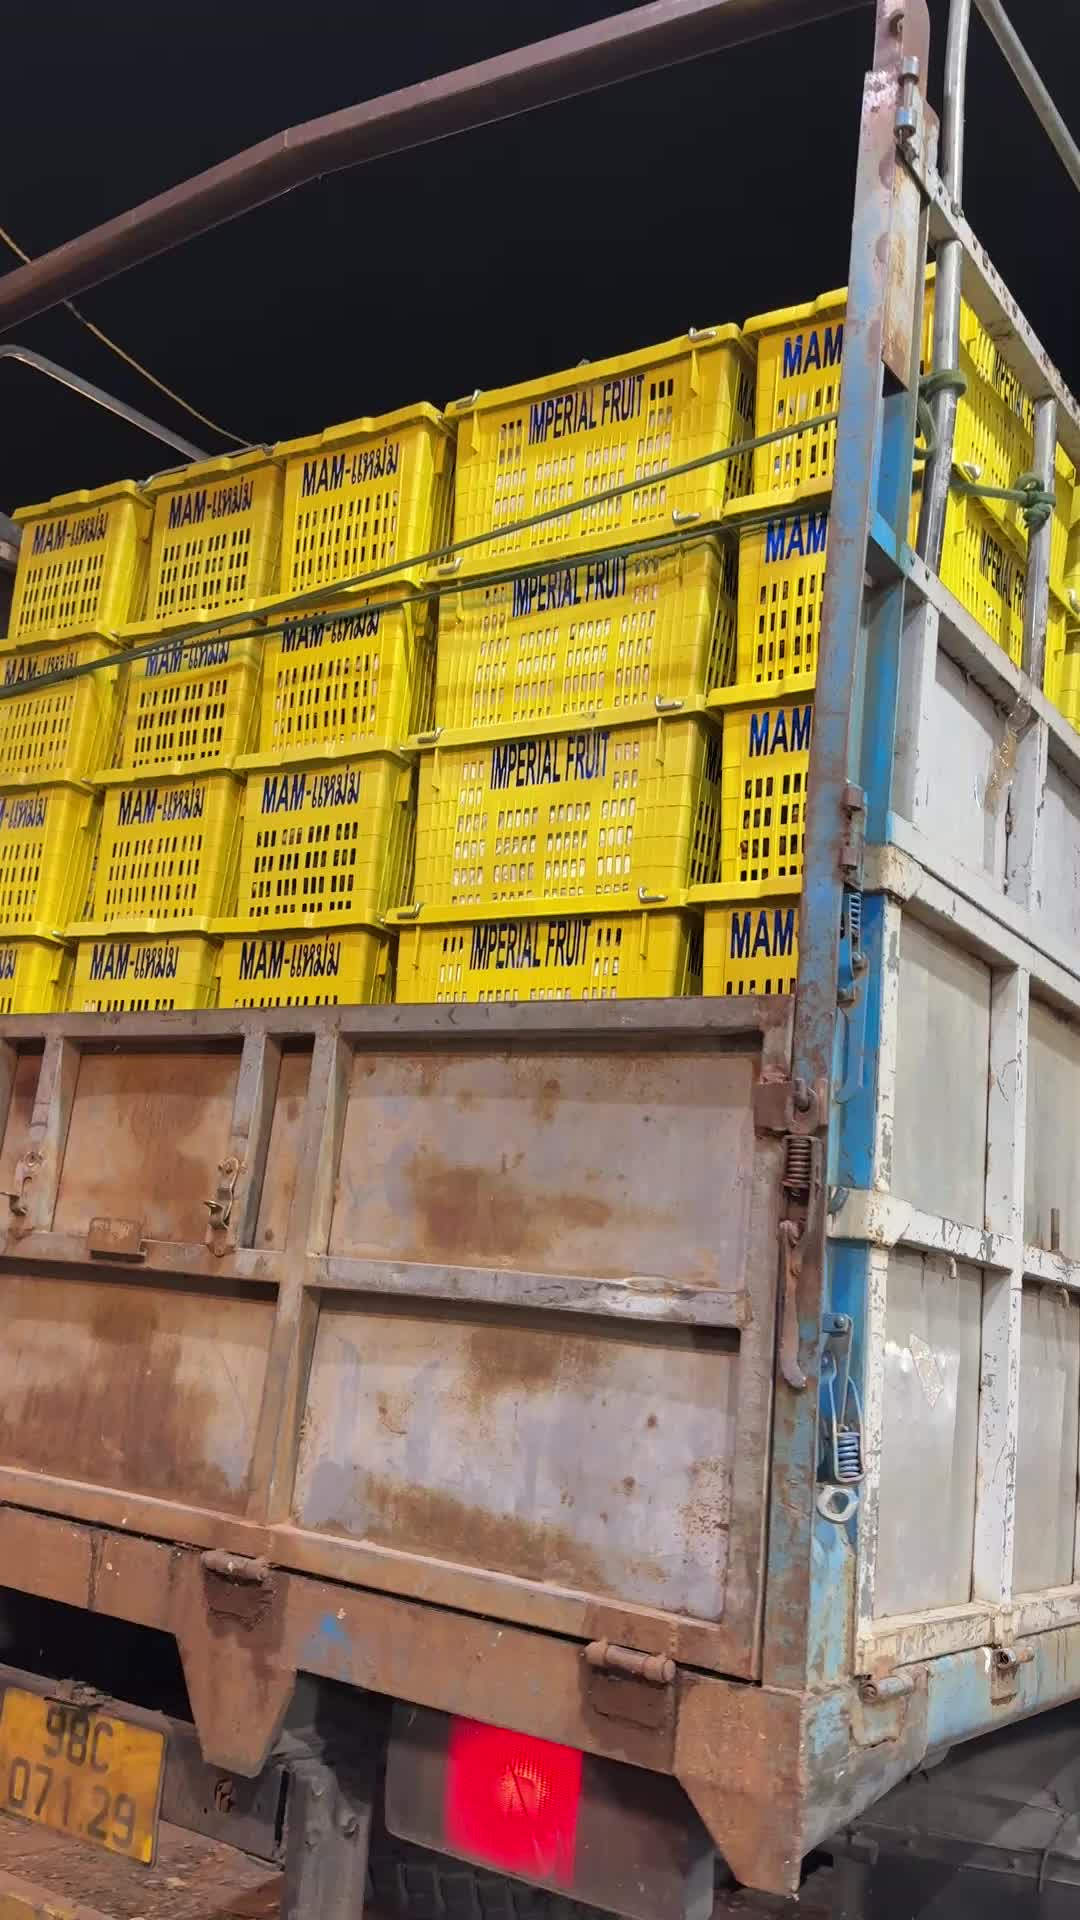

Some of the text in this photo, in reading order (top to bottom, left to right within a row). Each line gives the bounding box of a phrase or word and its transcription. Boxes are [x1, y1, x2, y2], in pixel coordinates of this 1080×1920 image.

[528, 374, 645, 445] IMPERIAL FRUIT
[512, 557, 627, 617] IMPERIAL FRUIT
[490, 732, 609, 790] IMPERIAL FRUIT
[469, 920, 591, 970] IMPERIAL FRUIT
[730, 909, 794, 959] MAM
[43, 1702, 113, 1771] 98C
